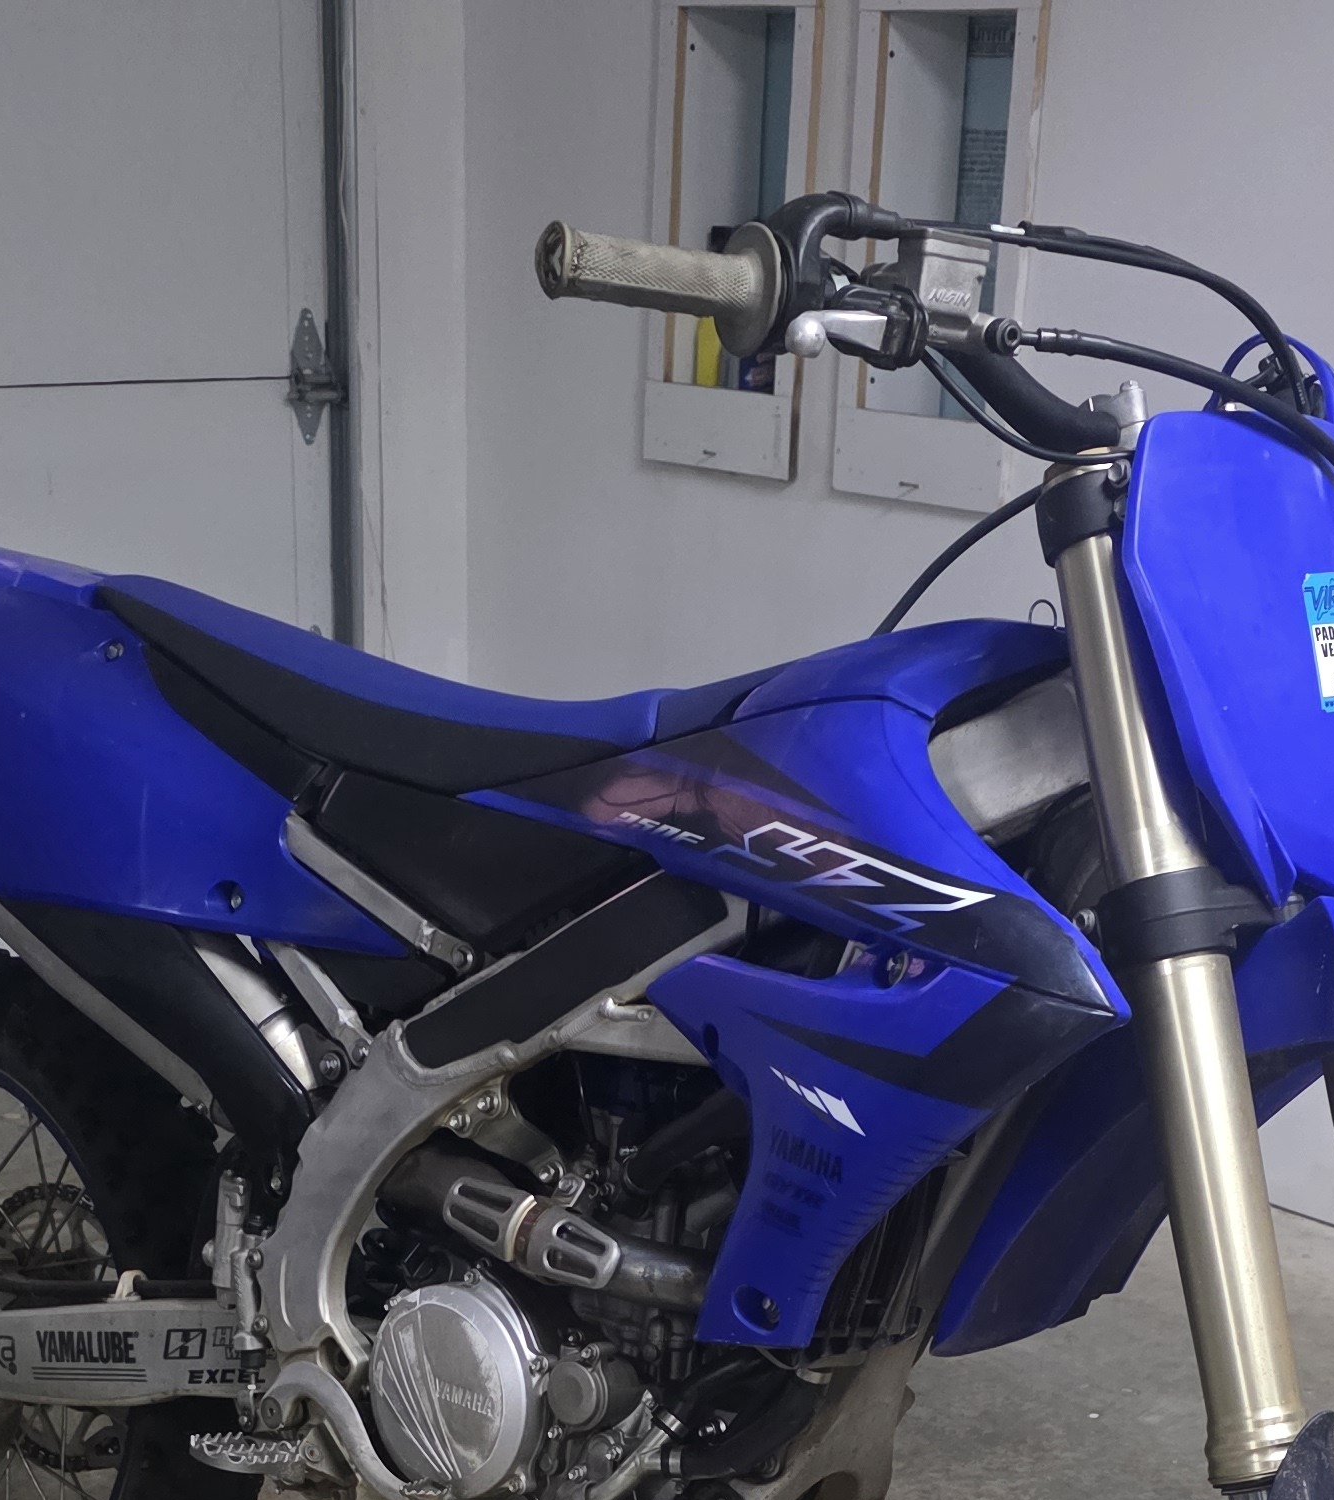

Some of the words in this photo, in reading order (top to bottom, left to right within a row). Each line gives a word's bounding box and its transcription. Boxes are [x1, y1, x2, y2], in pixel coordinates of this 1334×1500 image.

[770, 1125, 843, 1184] YAMAHA
[36, 1330, 138, 1364] YAMALUBE
[188, 1368, 266, 1384] EXCEL
[435, 1377, 495, 1418] YAMAHA
